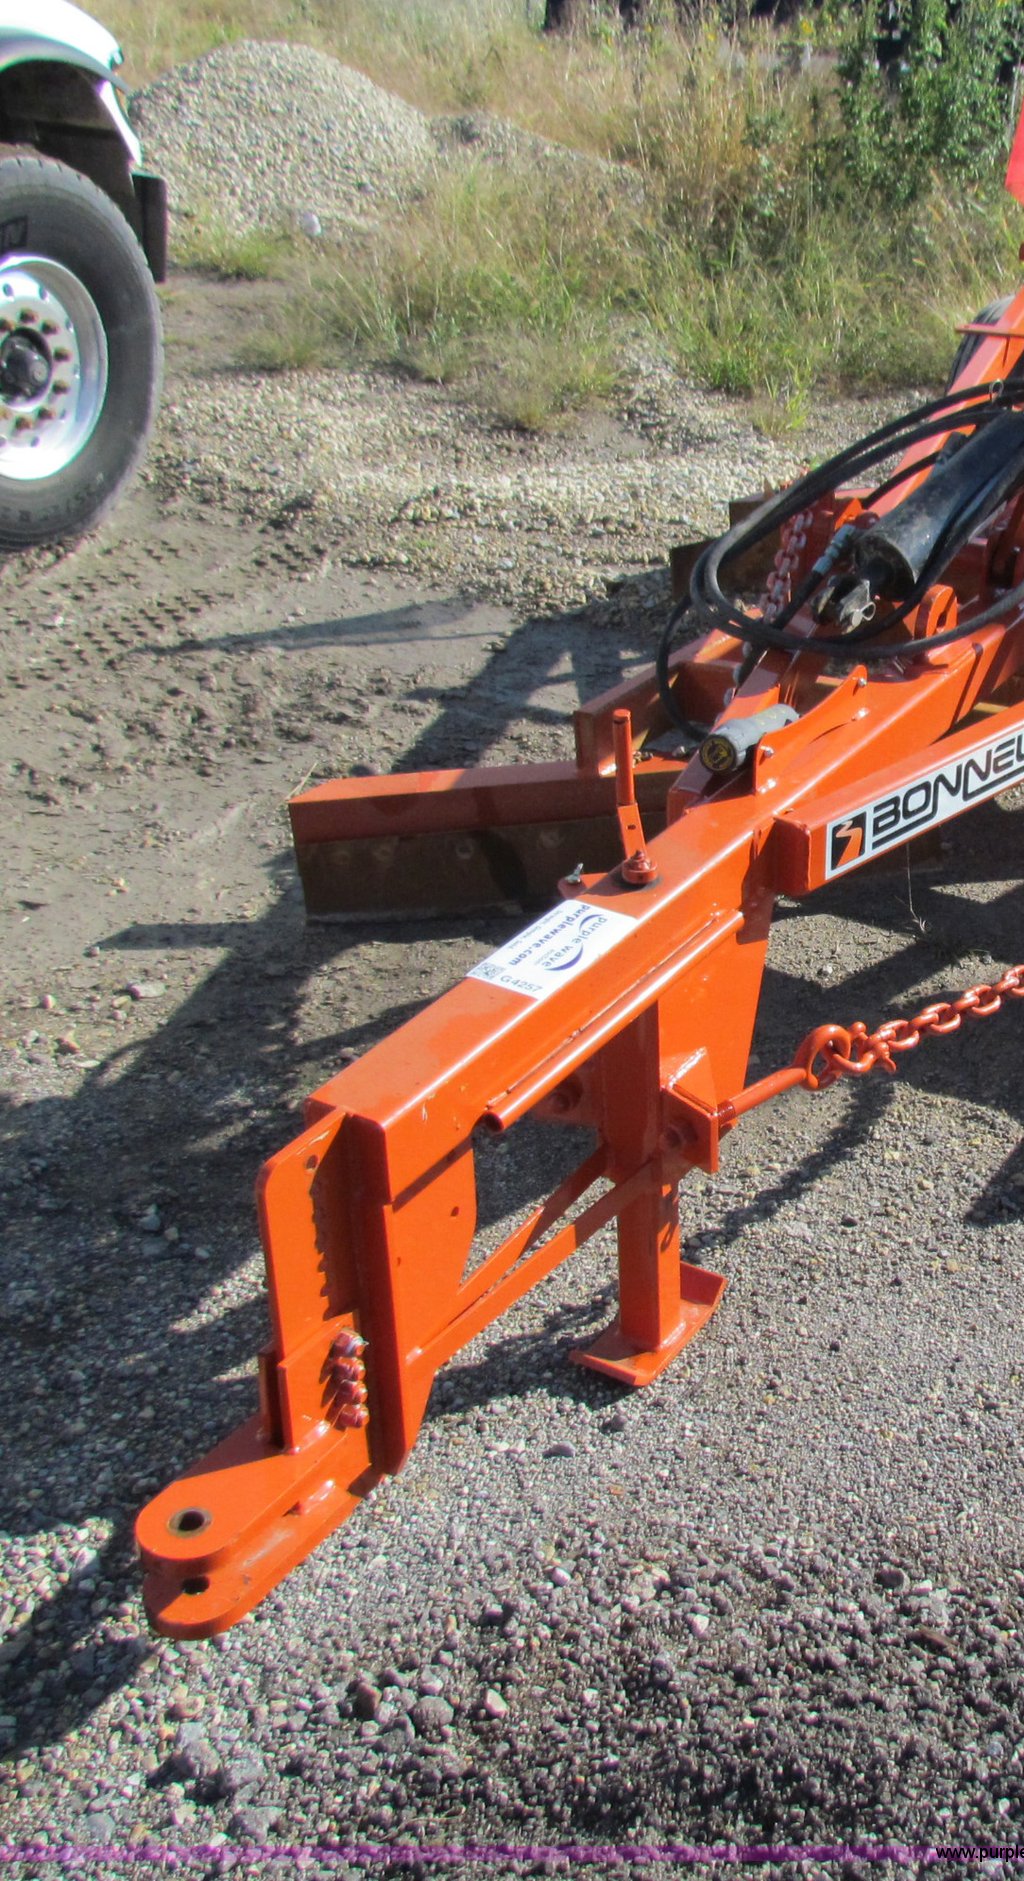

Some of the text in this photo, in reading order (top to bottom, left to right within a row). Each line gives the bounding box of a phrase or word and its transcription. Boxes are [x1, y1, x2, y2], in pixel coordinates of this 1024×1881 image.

[510, 904, 591, 966] purplewave.com
[574, 915, 608, 945] purple
[541, 943, 573, 968] wave
[499, 975, 544, 993] G4257
